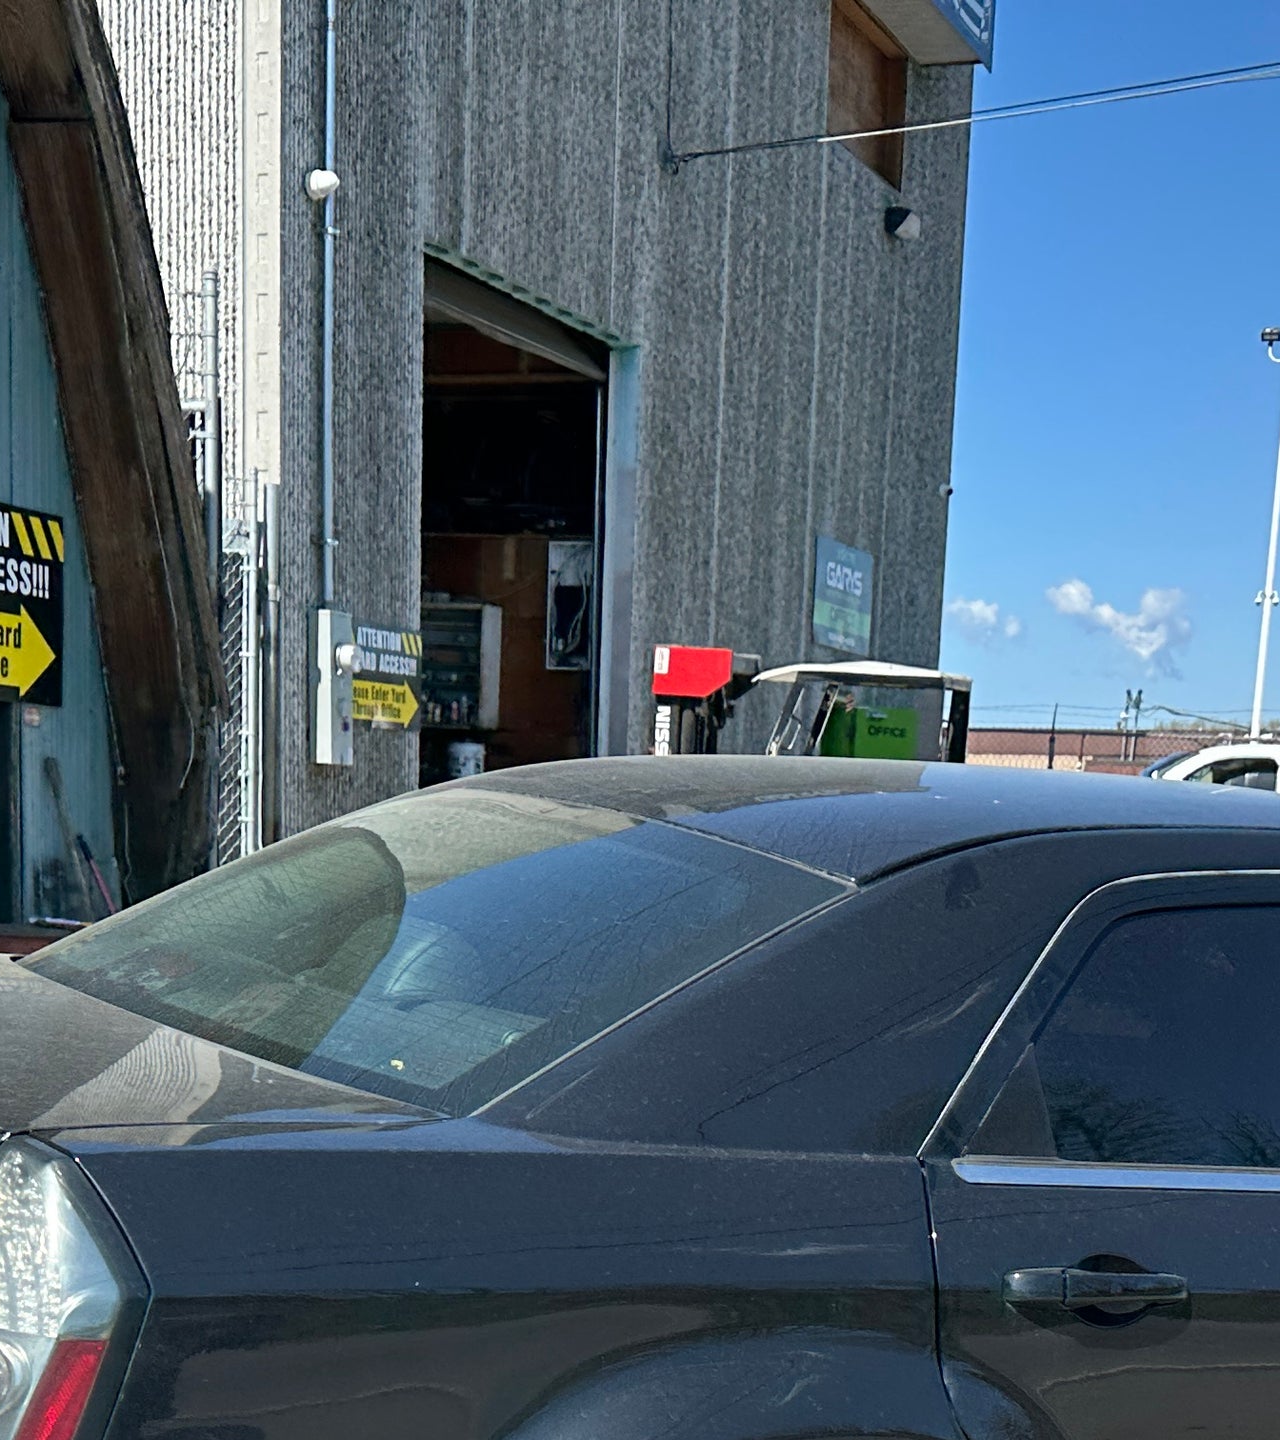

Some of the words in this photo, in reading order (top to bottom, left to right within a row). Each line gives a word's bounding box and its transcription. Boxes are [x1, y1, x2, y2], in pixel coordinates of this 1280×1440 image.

[357, 626, 401, 652] ATTENTION
[655, 705, 671, 756] NISS
[867, 724, 907, 738] OFFICE
